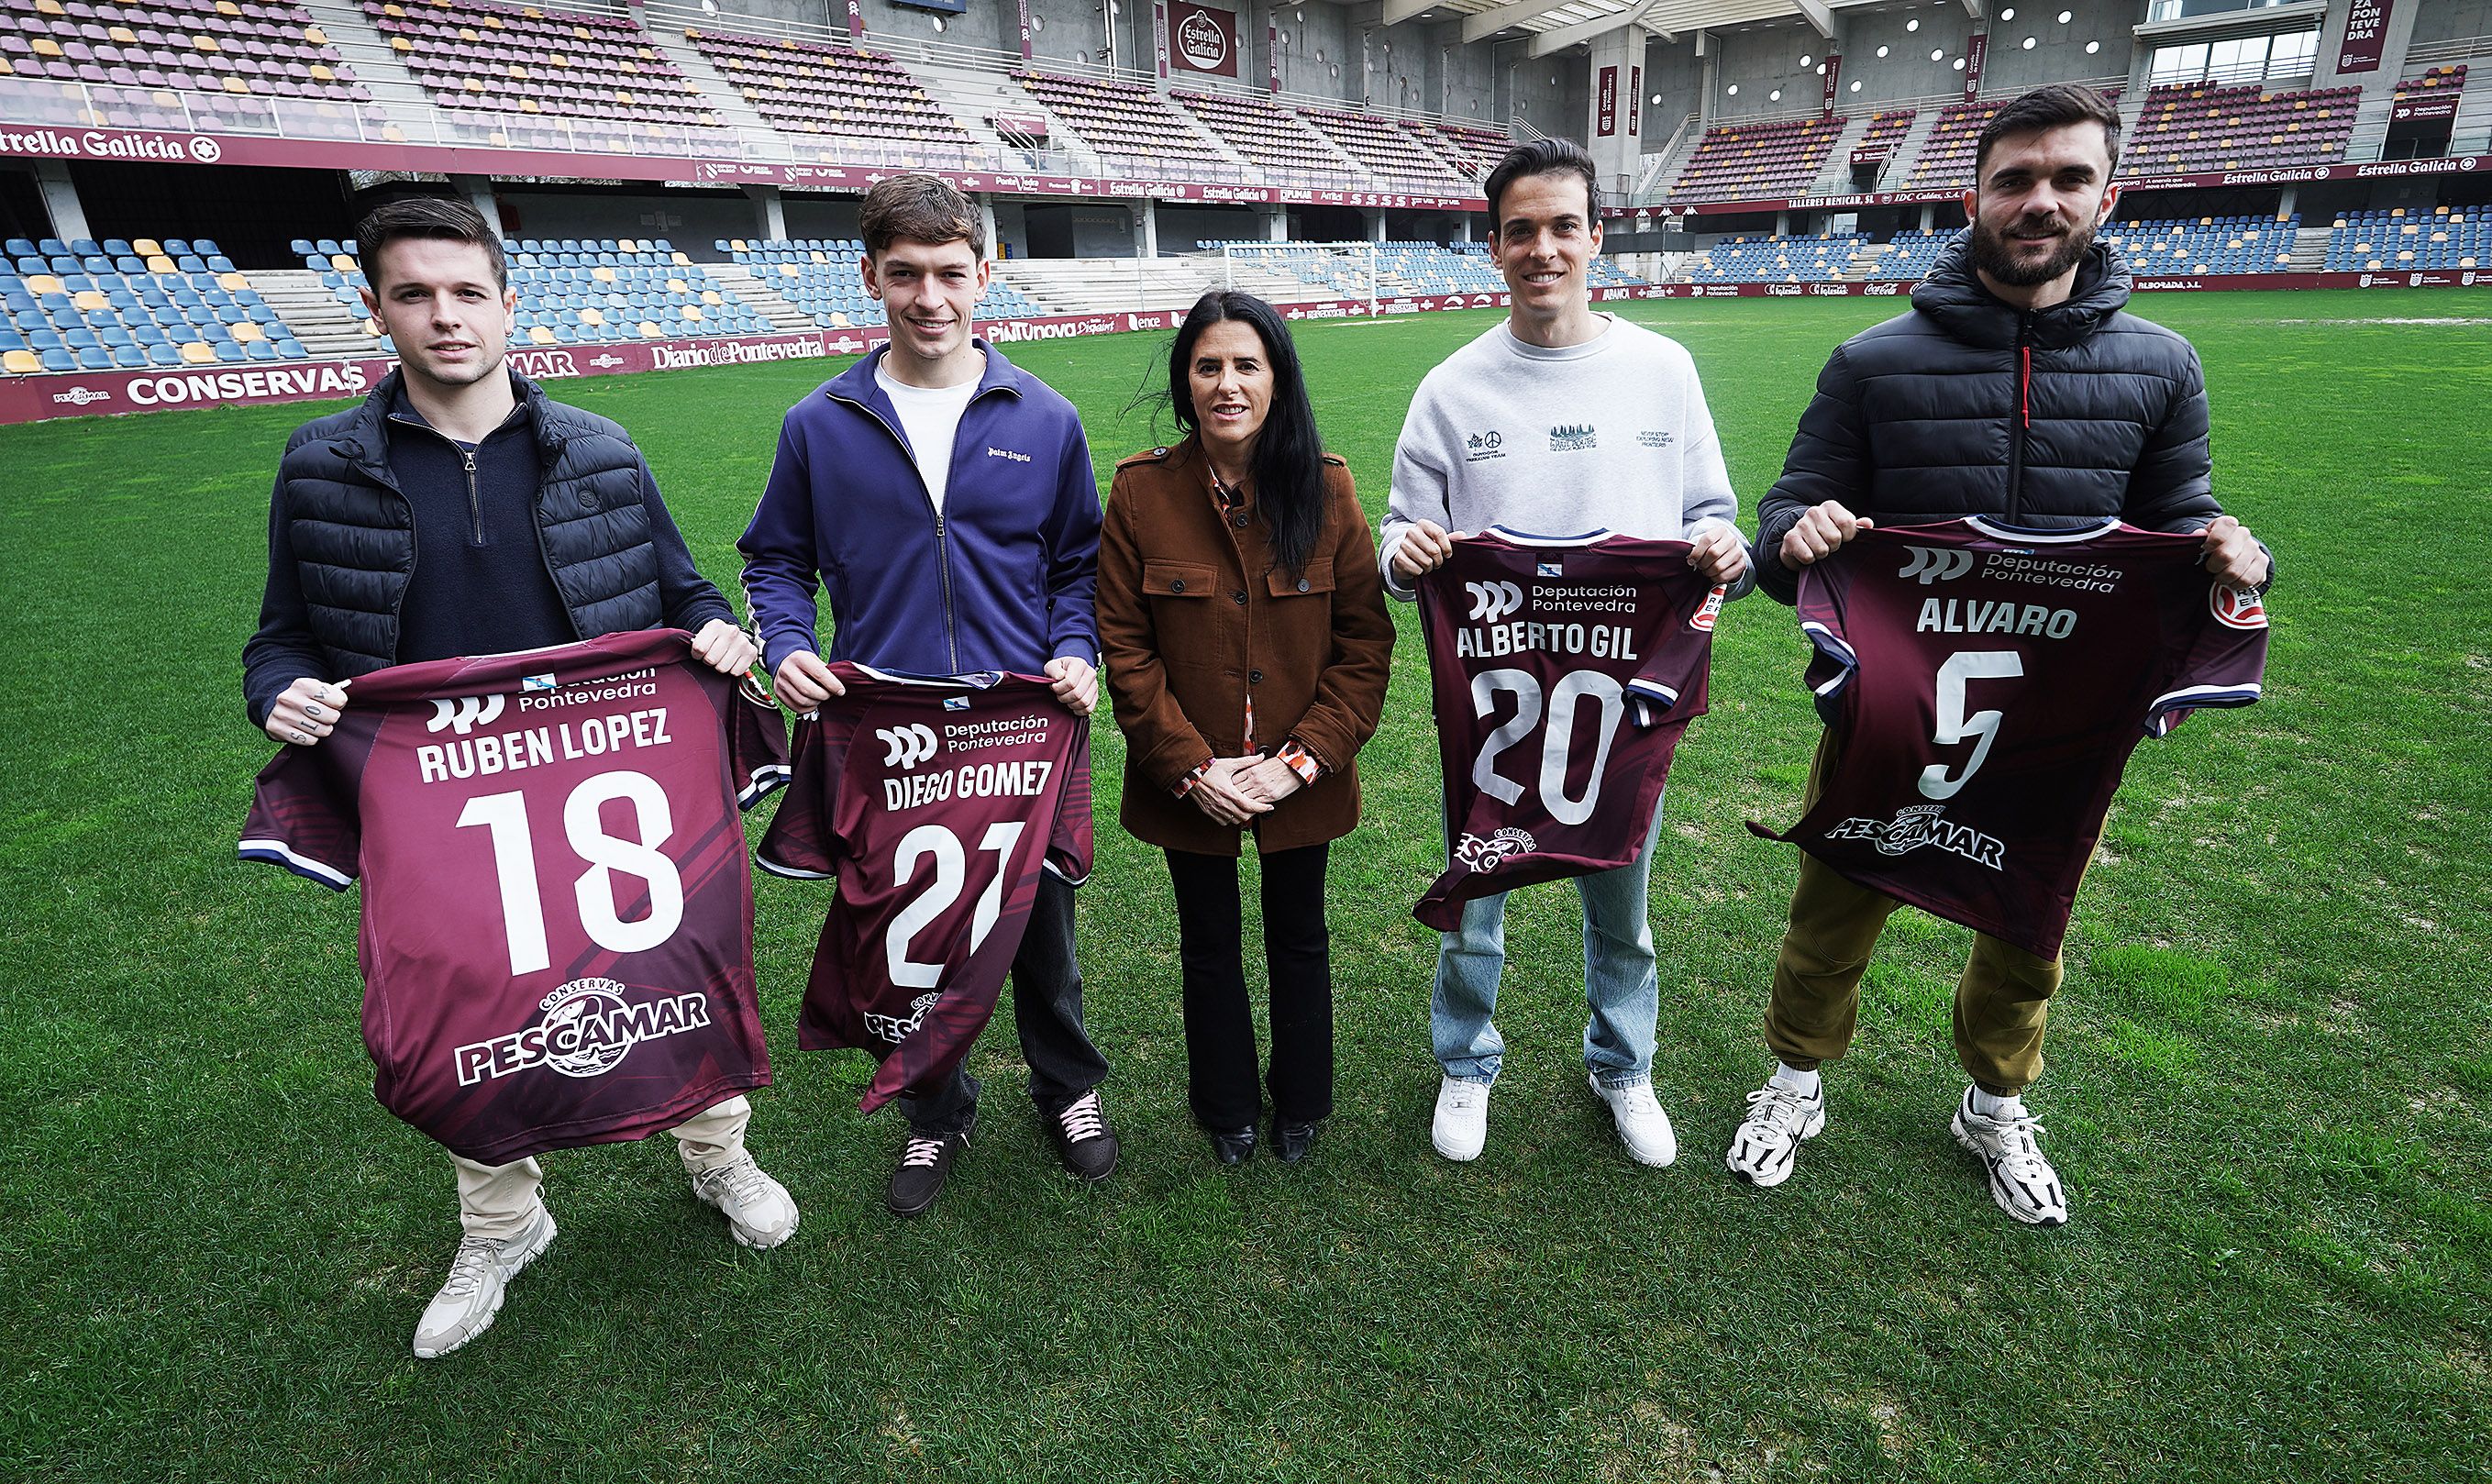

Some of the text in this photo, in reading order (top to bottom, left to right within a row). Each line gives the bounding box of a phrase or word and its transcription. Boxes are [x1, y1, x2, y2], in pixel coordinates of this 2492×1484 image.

[2350, 17, 2381, 30] TEVE
[2352, 7, 2381, 19] PON
[1184, 24, 1221, 44] Estrella
[2347, 29, 2374, 40] DRA
[1187, 39, 1220, 59] Galicia
[82, 131, 186, 161] Galicia
[2223, 168, 2311, 184] Estrella Galicia
[2356, 160, 2456, 177] Estrella Galicia
[1110, 182, 1145, 195] Estrella
[1145, 183, 1176, 197] Galicia
[1202, 186, 1259, 201] Estrella Galicia
[1894, 193, 1915, 203] IDC
[1915, 192, 1944, 201] Caldas,
[1789, 197, 1824, 208] TALLERES
[1865, 194, 1876, 204] SL
[1602, 287, 1630, 301] ABANCA
[1137, 316, 1161, 328] ence
[127, 366, 367, 405] CONSERVAS
[988, 446, 1008, 457] Palm
[1986, 553, 2124, 581] Deputación
[1532, 582, 1637, 600] Deputación
[1981, 566, 2116, 595] Pontevedra
[1532, 599, 1637, 615] Pontevedra
[1916, 597, 2078, 639] ALVARO
[1456, 623, 1638, 661] ALBERTO GIL
[518, 682, 657, 713] Pontevedra
[944, 714, 1049, 739] Deputación
[1918, 650, 2024, 800] 5
[416, 707, 672, 784] RUBEN LOPEZ
[947, 729, 1047, 754] Pontevedra
[1470, 668, 1627, 826] 20
[884, 769, 953, 814] DIEGO
[455, 770, 685, 978] 18
[539, 977, 626, 1011] CONSERVAS
[454, 992, 711, 1087] PESCAMAR
